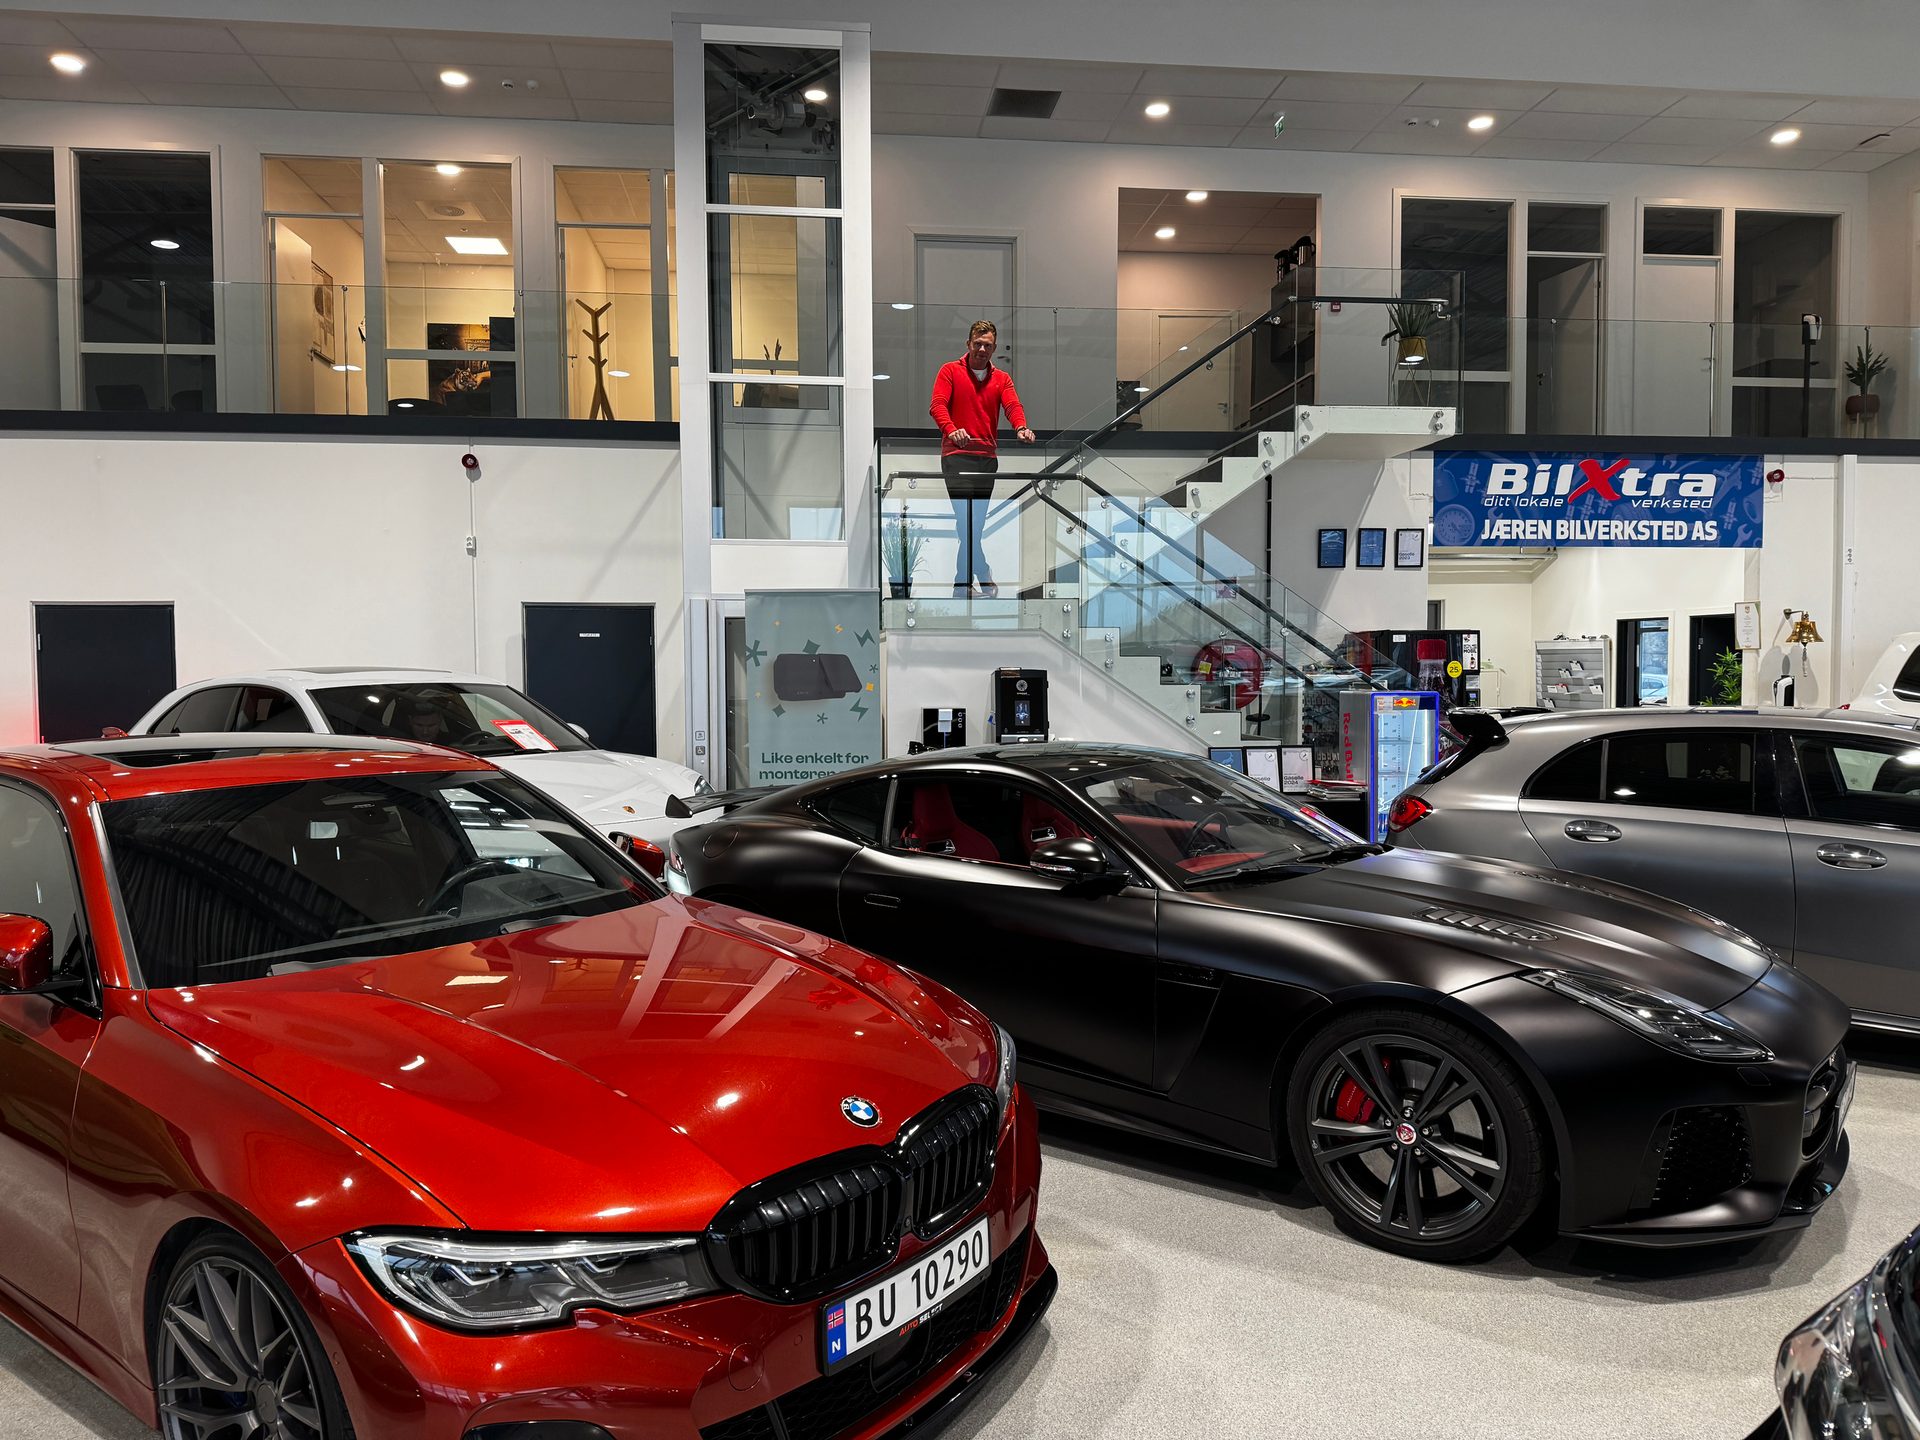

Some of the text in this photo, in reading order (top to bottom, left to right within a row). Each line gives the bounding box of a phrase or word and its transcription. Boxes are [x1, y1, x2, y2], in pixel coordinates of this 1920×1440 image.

[1486, 458, 1717, 504] BilXtra
[1484, 496, 1713, 508] ditt lokale verksted
[1481, 519, 1718, 541] JÆREN BILVERKSTED AS
[1343, 712, 1353, 748] Red
[761, 752, 869, 764] Like enkelt for
[856, 1229, 984, 1343] BU 10290
[899, 1319, 919, 1337] AUTO
[831, 1338, 841, 1355] N
